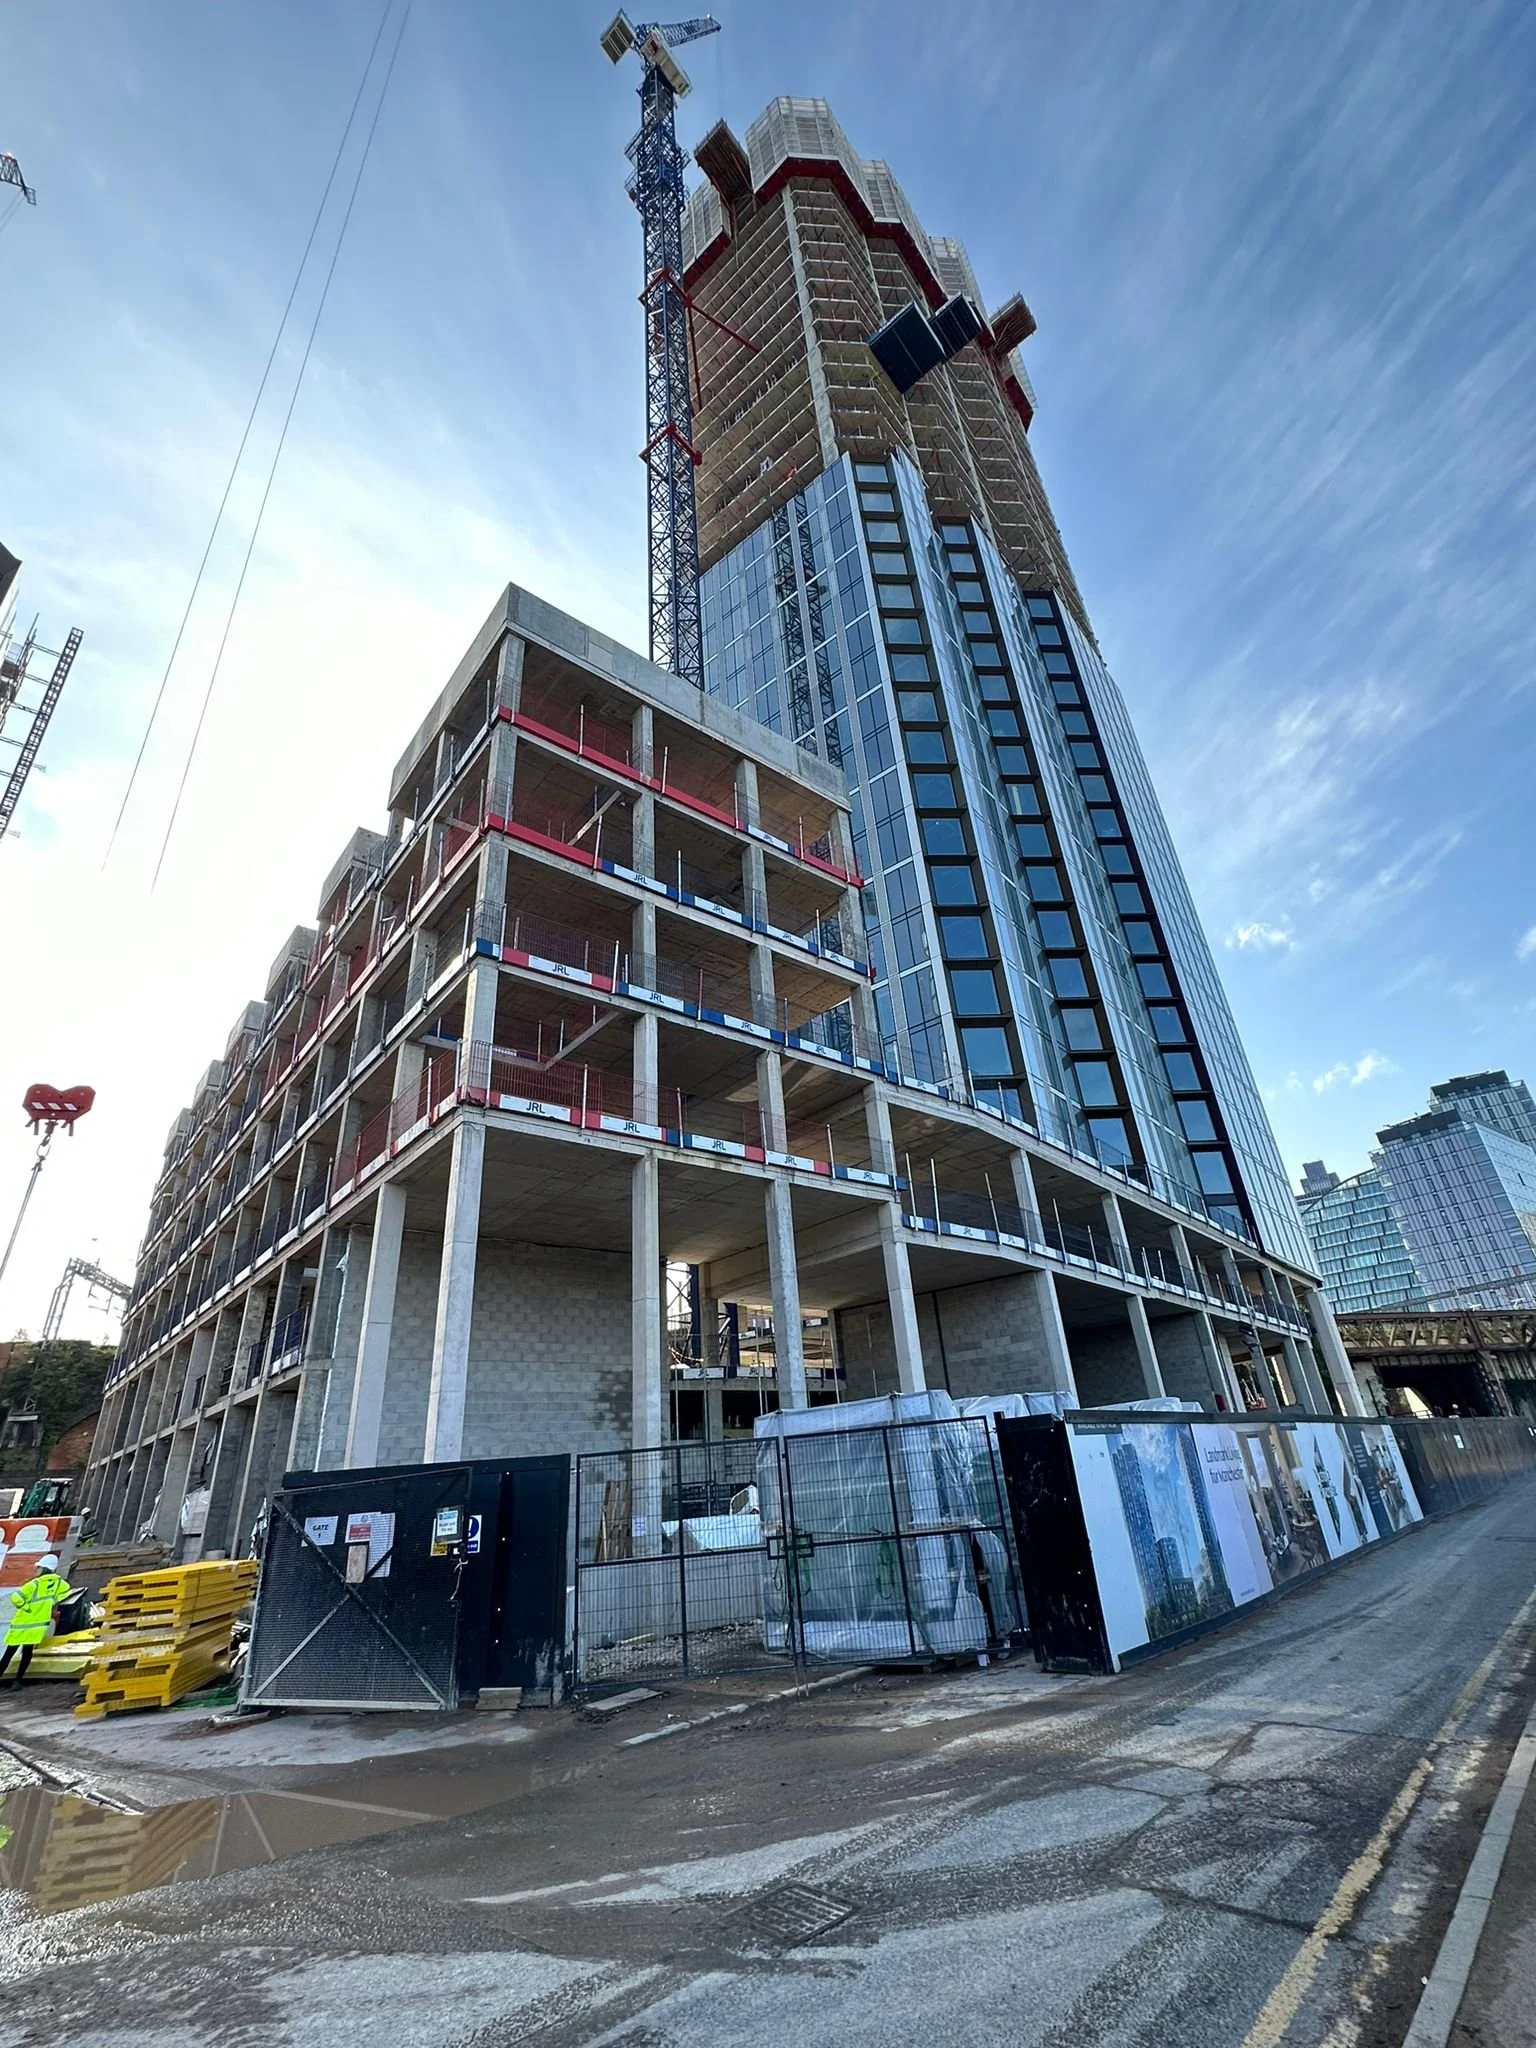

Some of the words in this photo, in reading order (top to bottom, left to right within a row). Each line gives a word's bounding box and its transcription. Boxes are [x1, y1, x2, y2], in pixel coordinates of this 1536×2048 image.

[634, 874, 648, 885] JRL
[712, 904, 725, 914] JRL
[551, 964, 569, 976] JRL
[650, 993, 665, 1004] JRL
[741, 1021, 754, 1031] JRL
[526, 1101, 546, 1114] JRL
[623, 1121, 640, 1133] JRL
[712, 1140, 726, 1151] JRL
[784, 1155, 797, 1166] JRL
